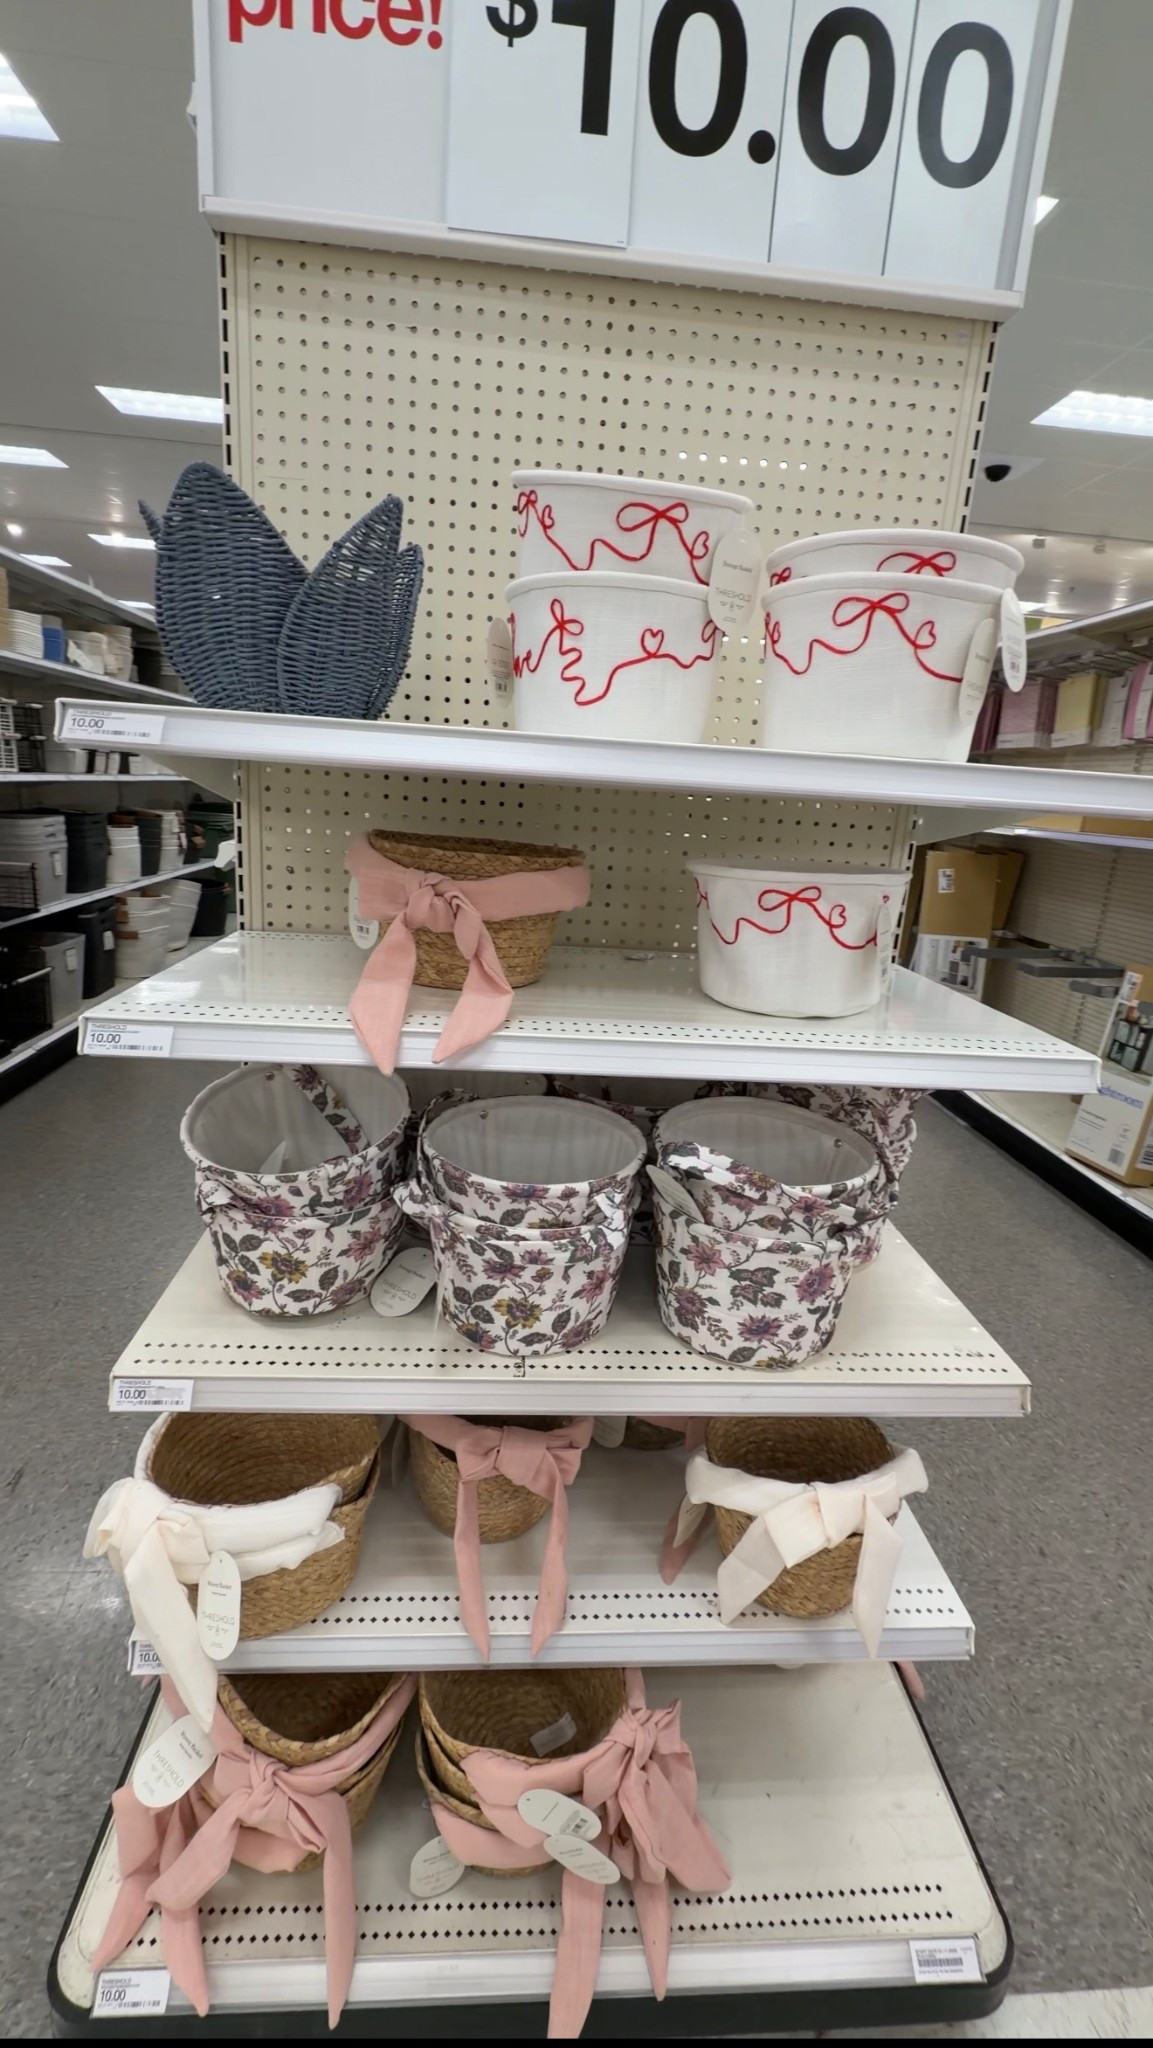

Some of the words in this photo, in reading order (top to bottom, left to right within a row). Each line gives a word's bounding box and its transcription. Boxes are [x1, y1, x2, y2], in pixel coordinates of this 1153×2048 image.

[71, 717, 105, 729] 10.00
[90, 1033, 121, 1044] 10.00
[119, 1389, 146, 1400] 10.00
[139, 1652, 161, 1663] 10.0
[101, 1989, 127, 2002] 10.00
